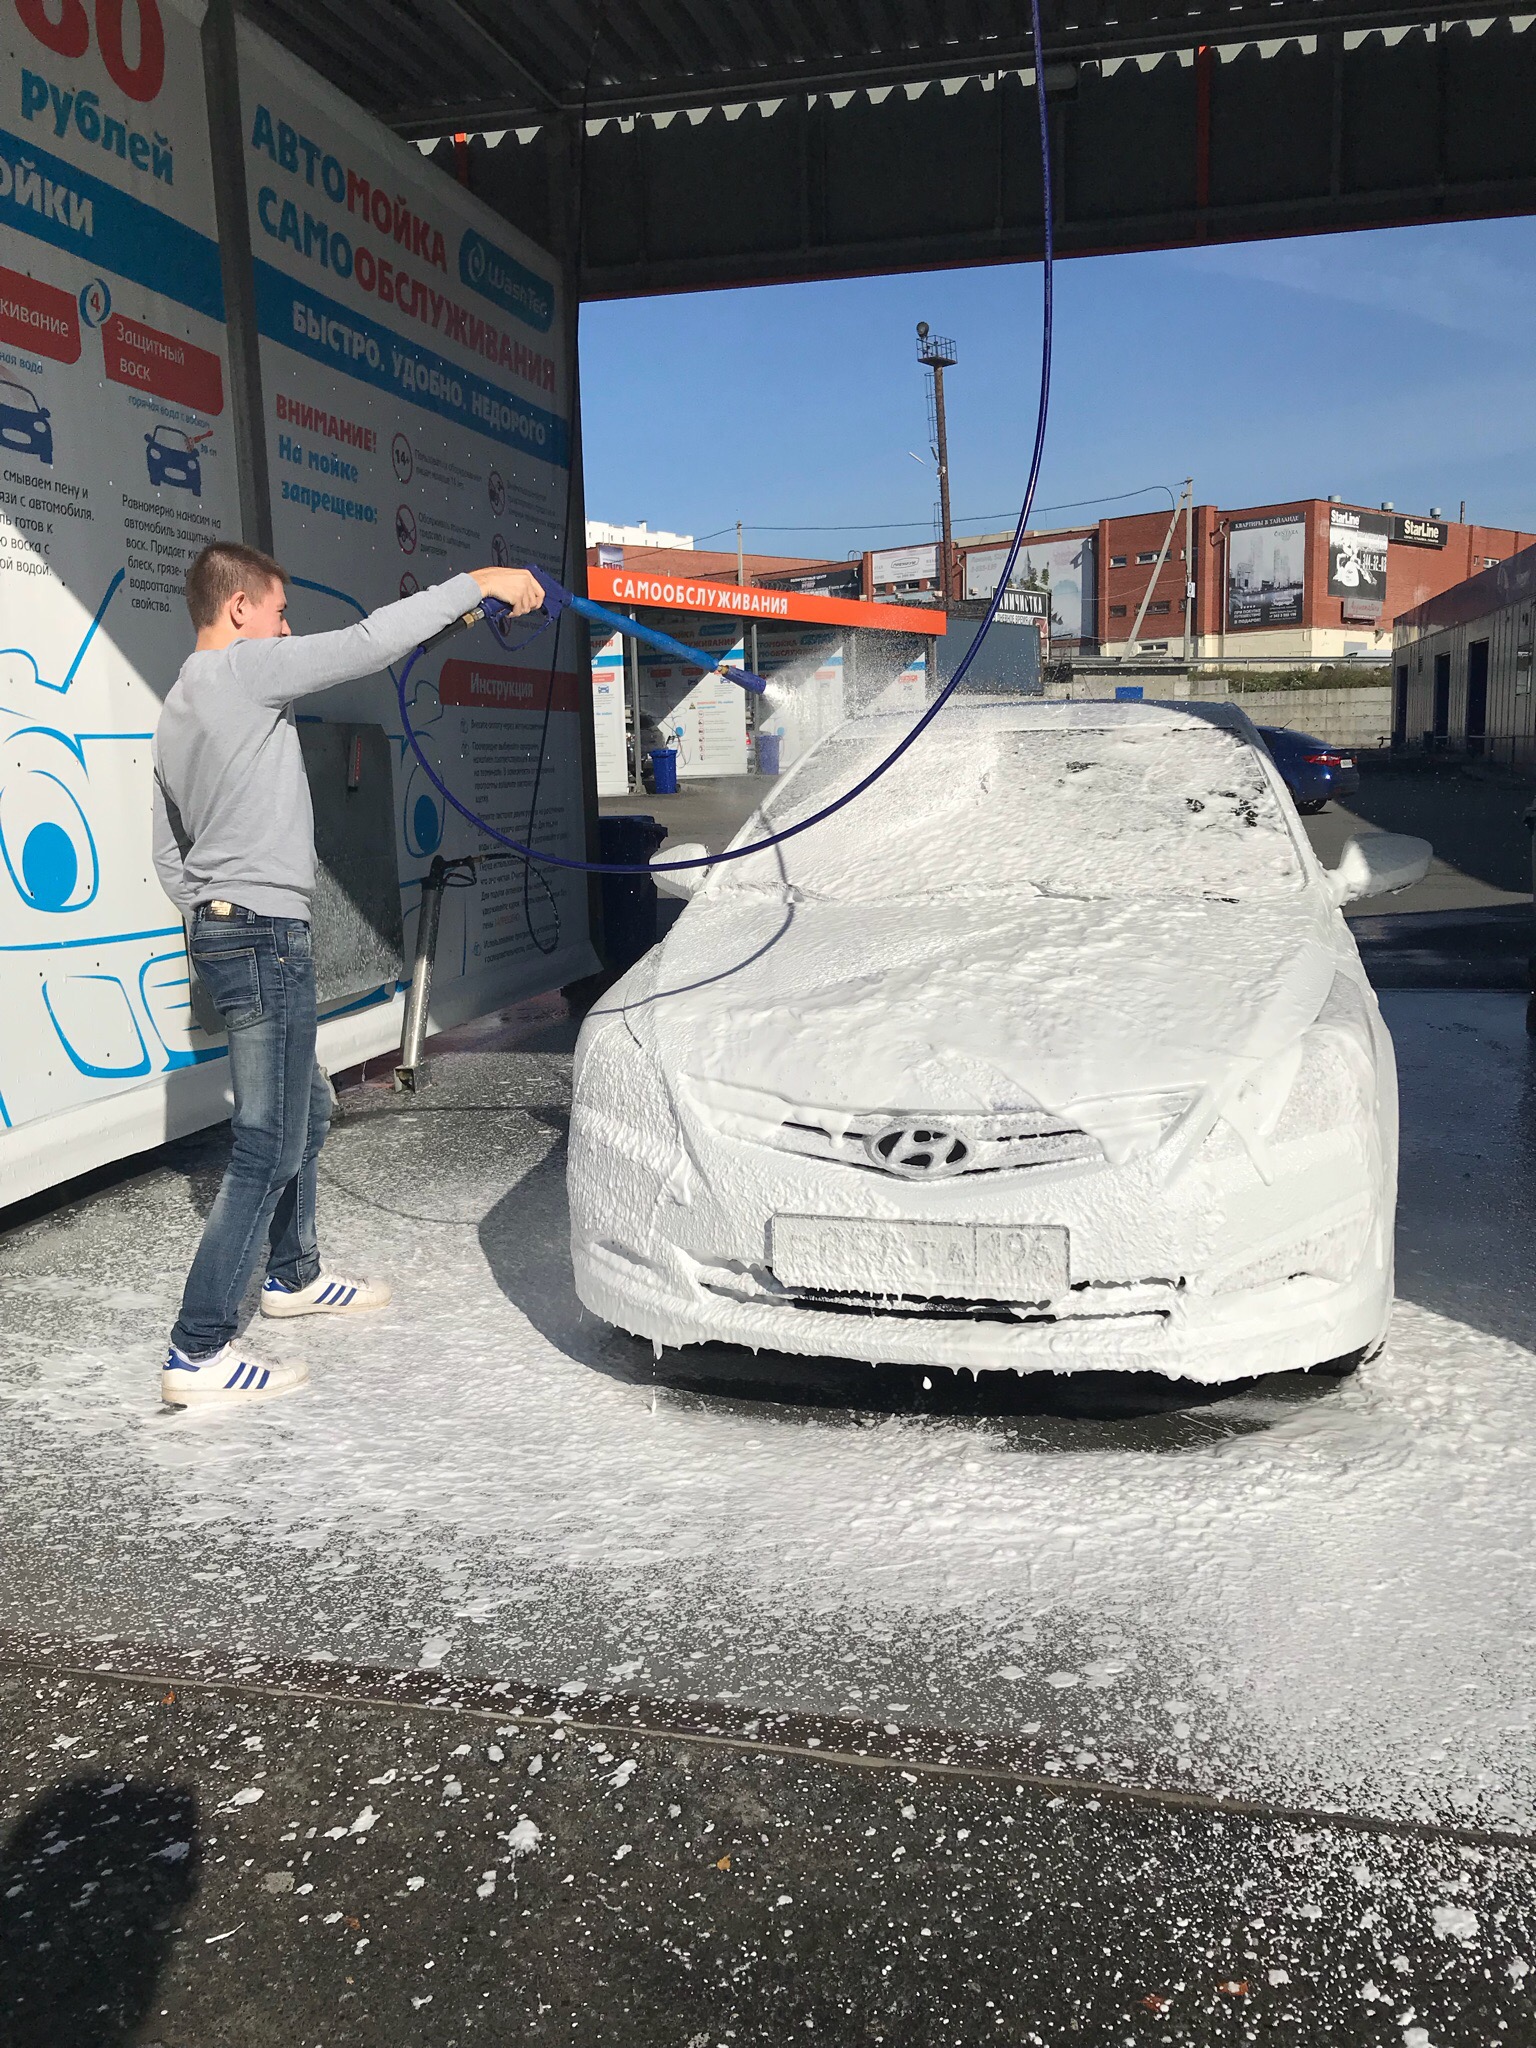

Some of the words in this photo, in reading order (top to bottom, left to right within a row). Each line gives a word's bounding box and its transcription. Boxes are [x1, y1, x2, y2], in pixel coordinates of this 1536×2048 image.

[21, 67, 174, 186] рублей
[252, 104, 448, 274] АВТОМОЙКА
[258, 186, 557, 394] САМООБСЛУЖИВАНИЯ
[487, 261, 549, 318] WashTec
[117, 320, 185, 366] Защитный
[19, 358, 43, 375] вода
[120, 358, 150, 382] воск
[292, 300, 385, 373] БЫСТРО.
[472, 391, 546, 445] НЕДОРОГО
[276, 393, 378, 452] ВНИМАНИЕ!
[278, 434, 303, 465] На
[308, 452, 360, 484] мойке
[3, 469, 52, 491] смываем
[54, 481, 80, 501] пену
[82, 487, 89, 499] и
[20, 495, 27, 508] с
[28, 497, 95, 521] автомобиля.
[122, 493, 175, 519] Равномерно
[176, 509, 210, 527] наносим
[211, 518, 222, 529] на
[1331, 509, 1360, 526] StarLine
[15, 515, 44, 533] готов
[46, 523, 54, 535] к
[123, 517, 176, 538] автомобиль
[1404, 519, 1440, 539] StarLine
[11, 537, 41, 554] воска
[44, 543, 51, 555] с
[126, 537, 148, 552] воск.
[16, 560, 52, 576] водой.
[127, 555, 155, 574] блеск,
[156, 562, 182, 577] грязе-
[131, 597, 172, 613] свойства.
[611, 577, 789, 616] САМООБСЛУЖИВАНИЯ
[998, 592, 1043, 614] ХИМЧИСТКА
[470, 672, 534, 701] Инструкция
